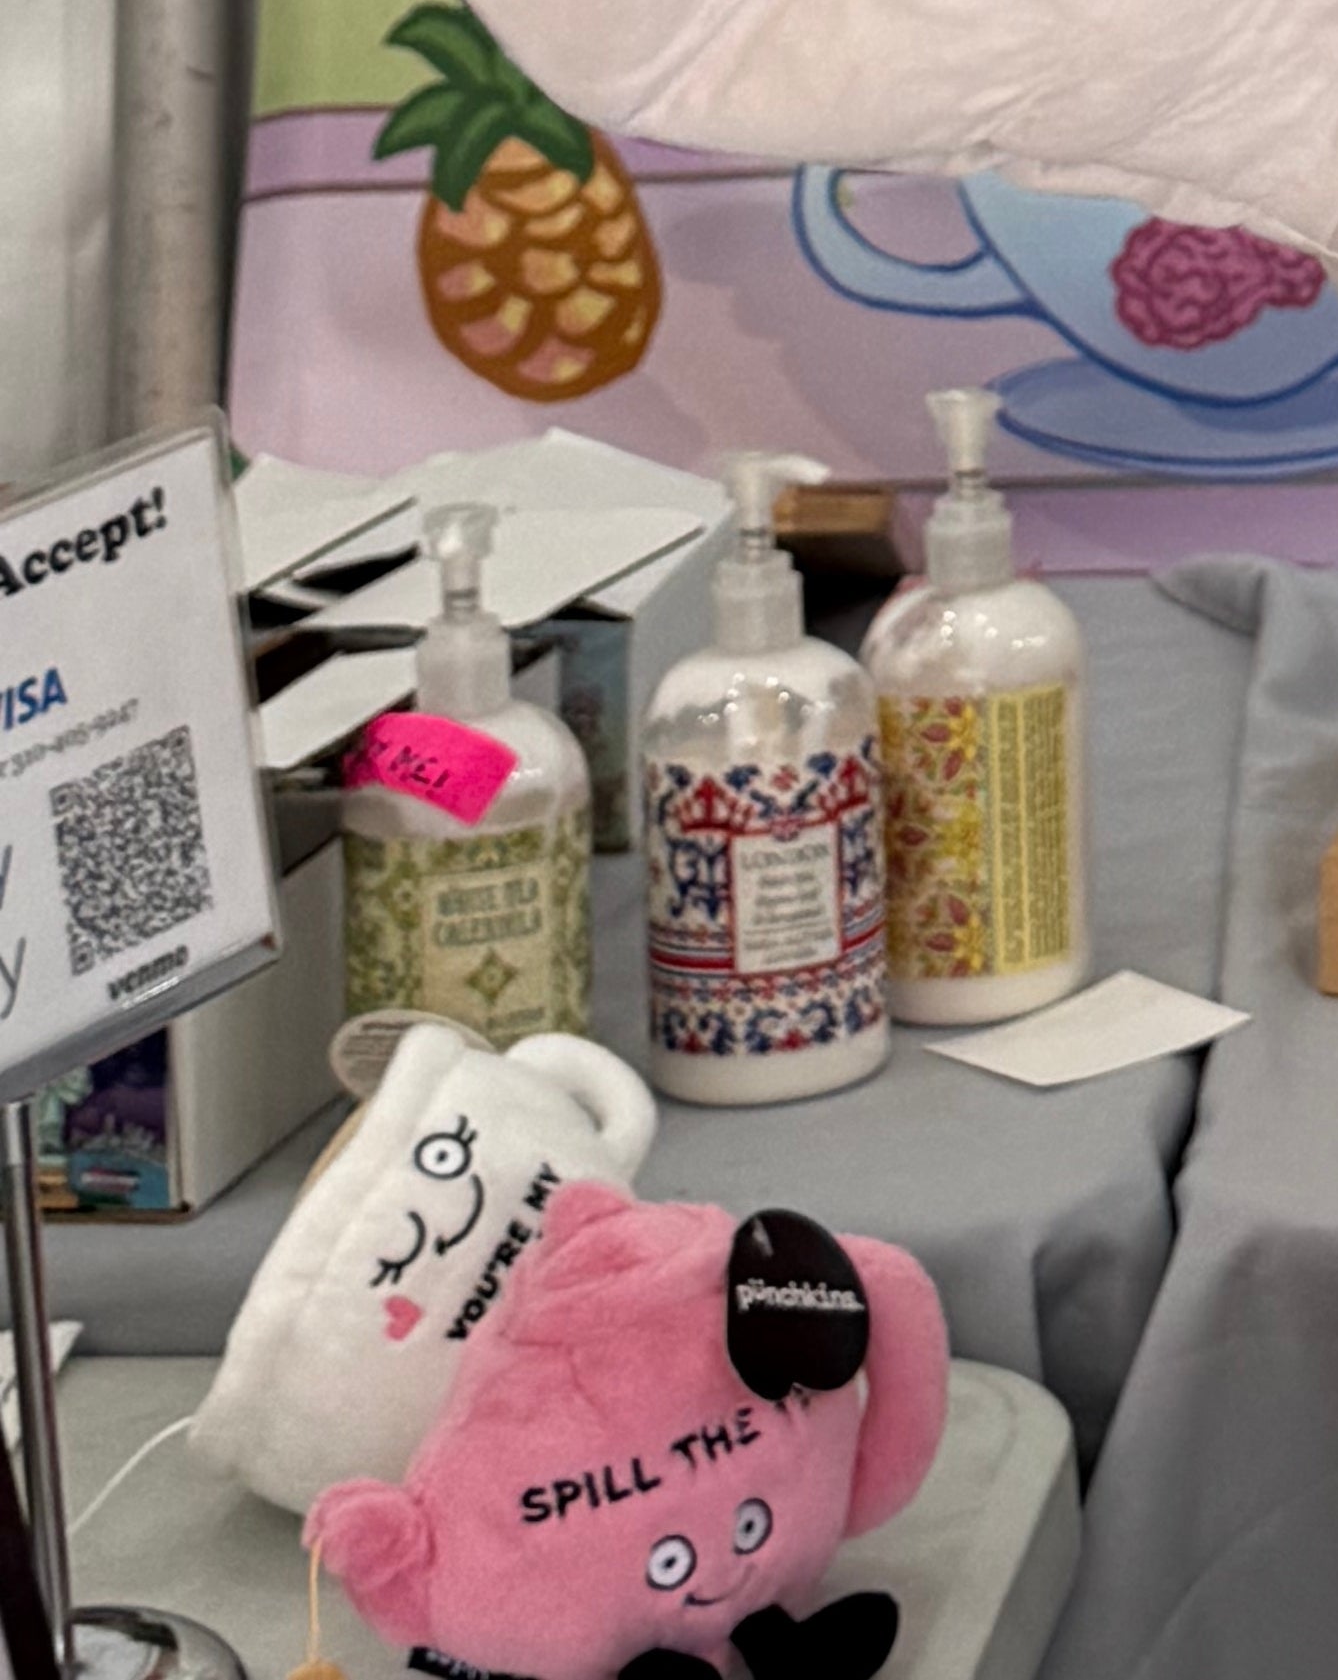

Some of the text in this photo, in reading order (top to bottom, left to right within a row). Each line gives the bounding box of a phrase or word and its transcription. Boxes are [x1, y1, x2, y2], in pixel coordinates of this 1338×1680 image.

[0, 666, 68, 731] ISA
[446, 1161, 561, 1340] YOU'RE MY
[520, 1406, 761, 1525] SPILL THE
